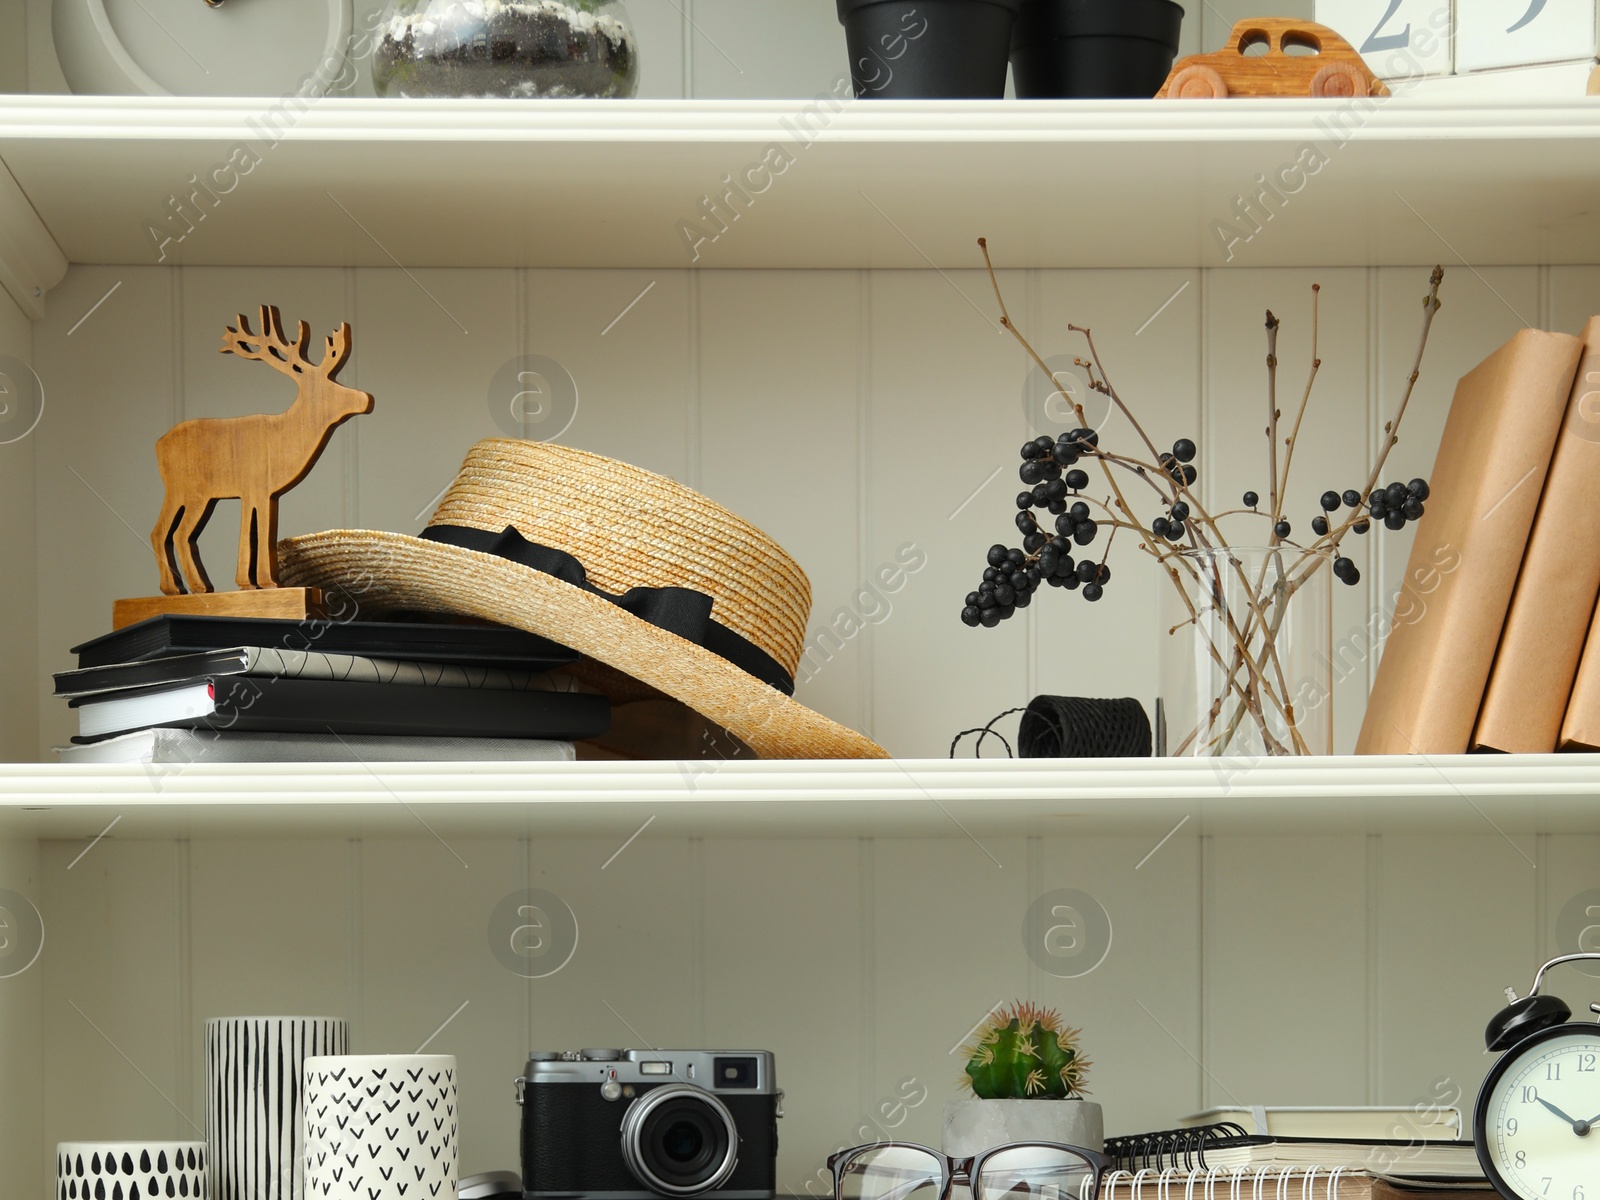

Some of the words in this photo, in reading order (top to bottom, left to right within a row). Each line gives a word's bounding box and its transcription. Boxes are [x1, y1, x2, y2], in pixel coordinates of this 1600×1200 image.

[1545, 1063, 1561, 1081] 11
[1577, 1054, 1596, 1073] 12
[1521, 1085, 1538, 1103] 10
[1506, 1117, 1518, 1137] 9
[1514, 1150, 1526, 1169] 8
[1541, 1177, 1553, 1196] 7
